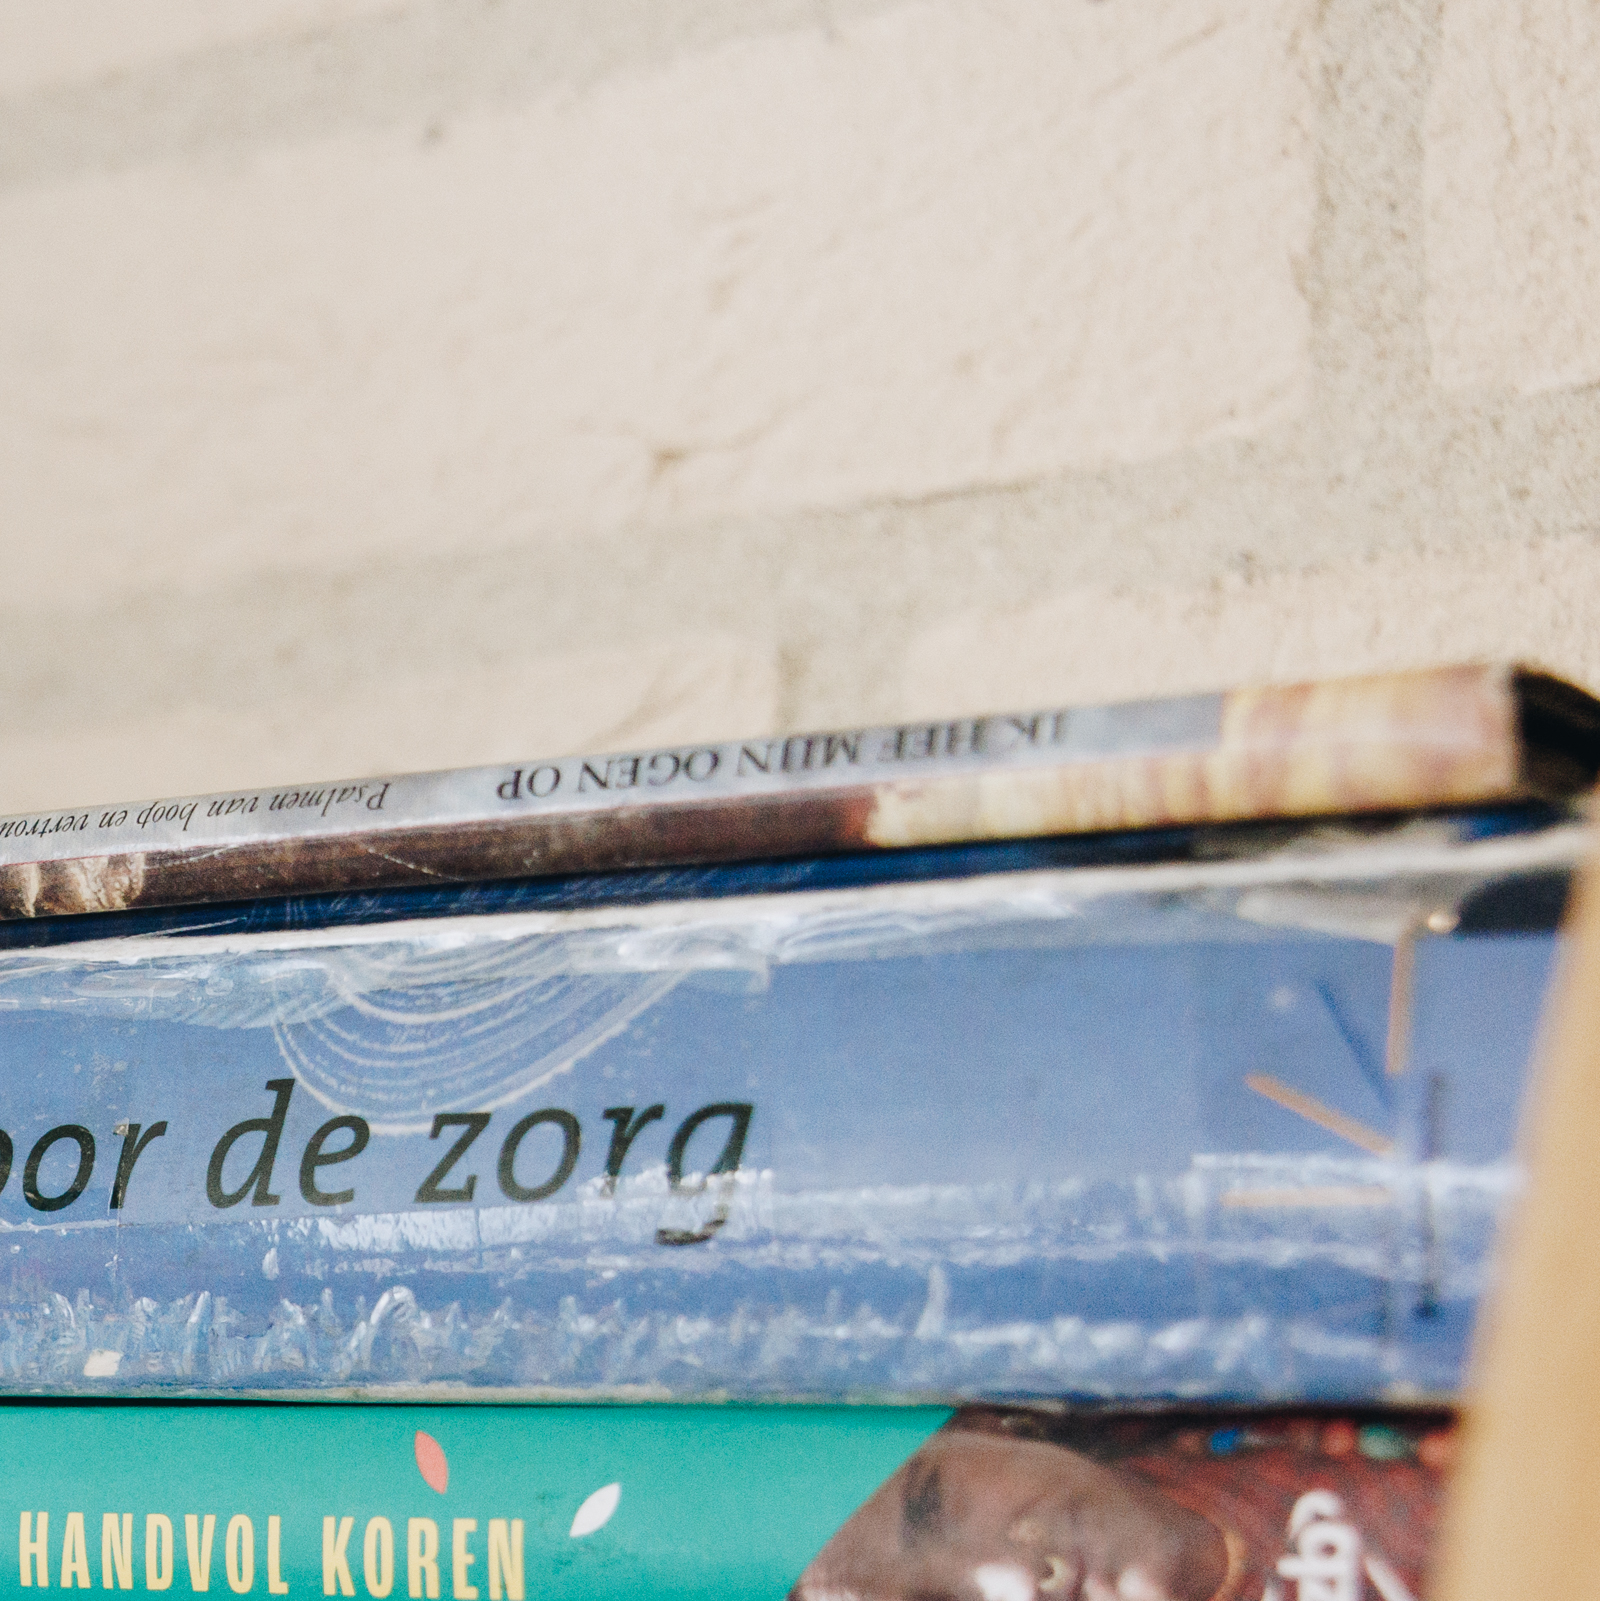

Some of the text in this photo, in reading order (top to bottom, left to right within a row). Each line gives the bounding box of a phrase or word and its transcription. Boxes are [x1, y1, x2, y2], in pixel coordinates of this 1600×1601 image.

[496, 709, 1069, 801] IK HEF MIJN OGEN OP
[137, 800, 198, 832] hoop
[207, 796, 259, 818] van
[269, 781, 393, 818] Psalmen
[99, 809, 128, 830] en
[204, 1078, 371, 1208] de
[413, 1100, 757, 1246] zorg
[18, 1510, 290, 1595] HANDVOL
[321, 1515, 526, 1601] KOREN
